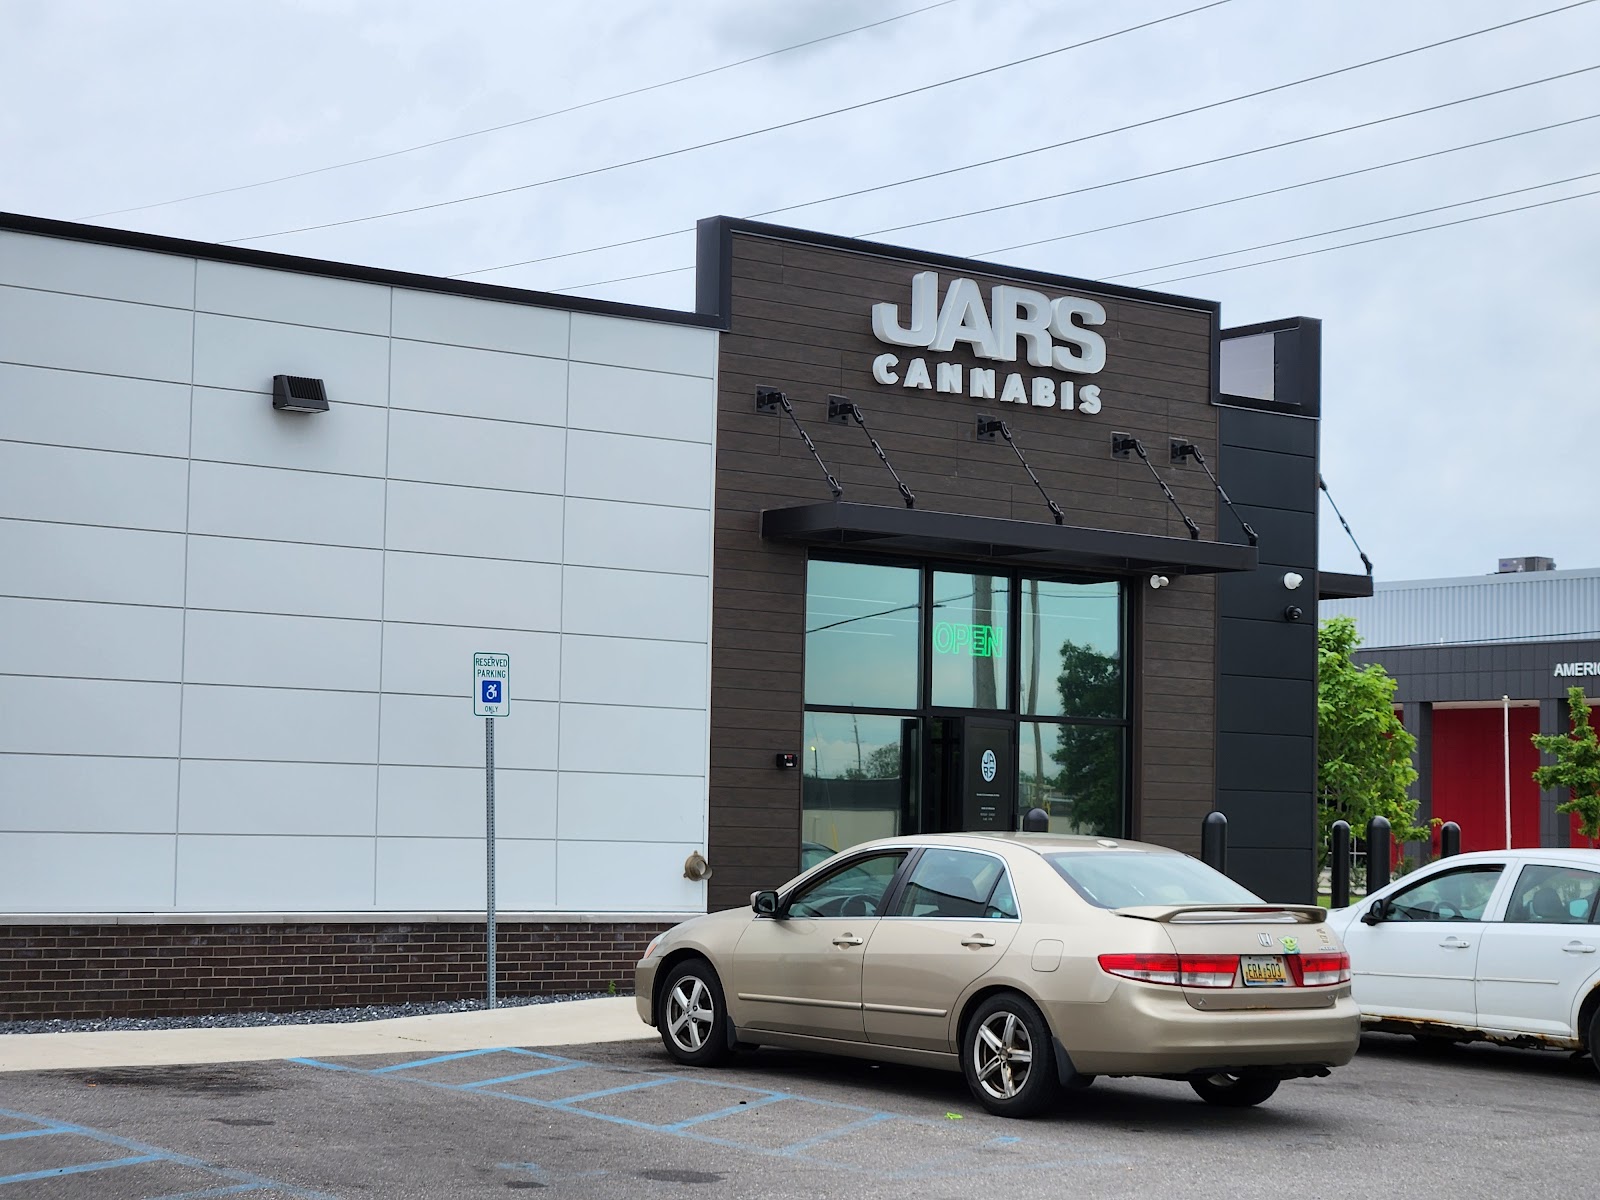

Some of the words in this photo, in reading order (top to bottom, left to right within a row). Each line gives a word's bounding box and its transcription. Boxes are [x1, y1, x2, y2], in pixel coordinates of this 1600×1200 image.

[872, 271, 1106, 374] JARS
[872, 353, 1101, 414] CANNABIS
[934, 621, 1003, 657] OPEN
[475, 658, 507, 667] RESERVED
[477, 669, 506, 678] PARKING
